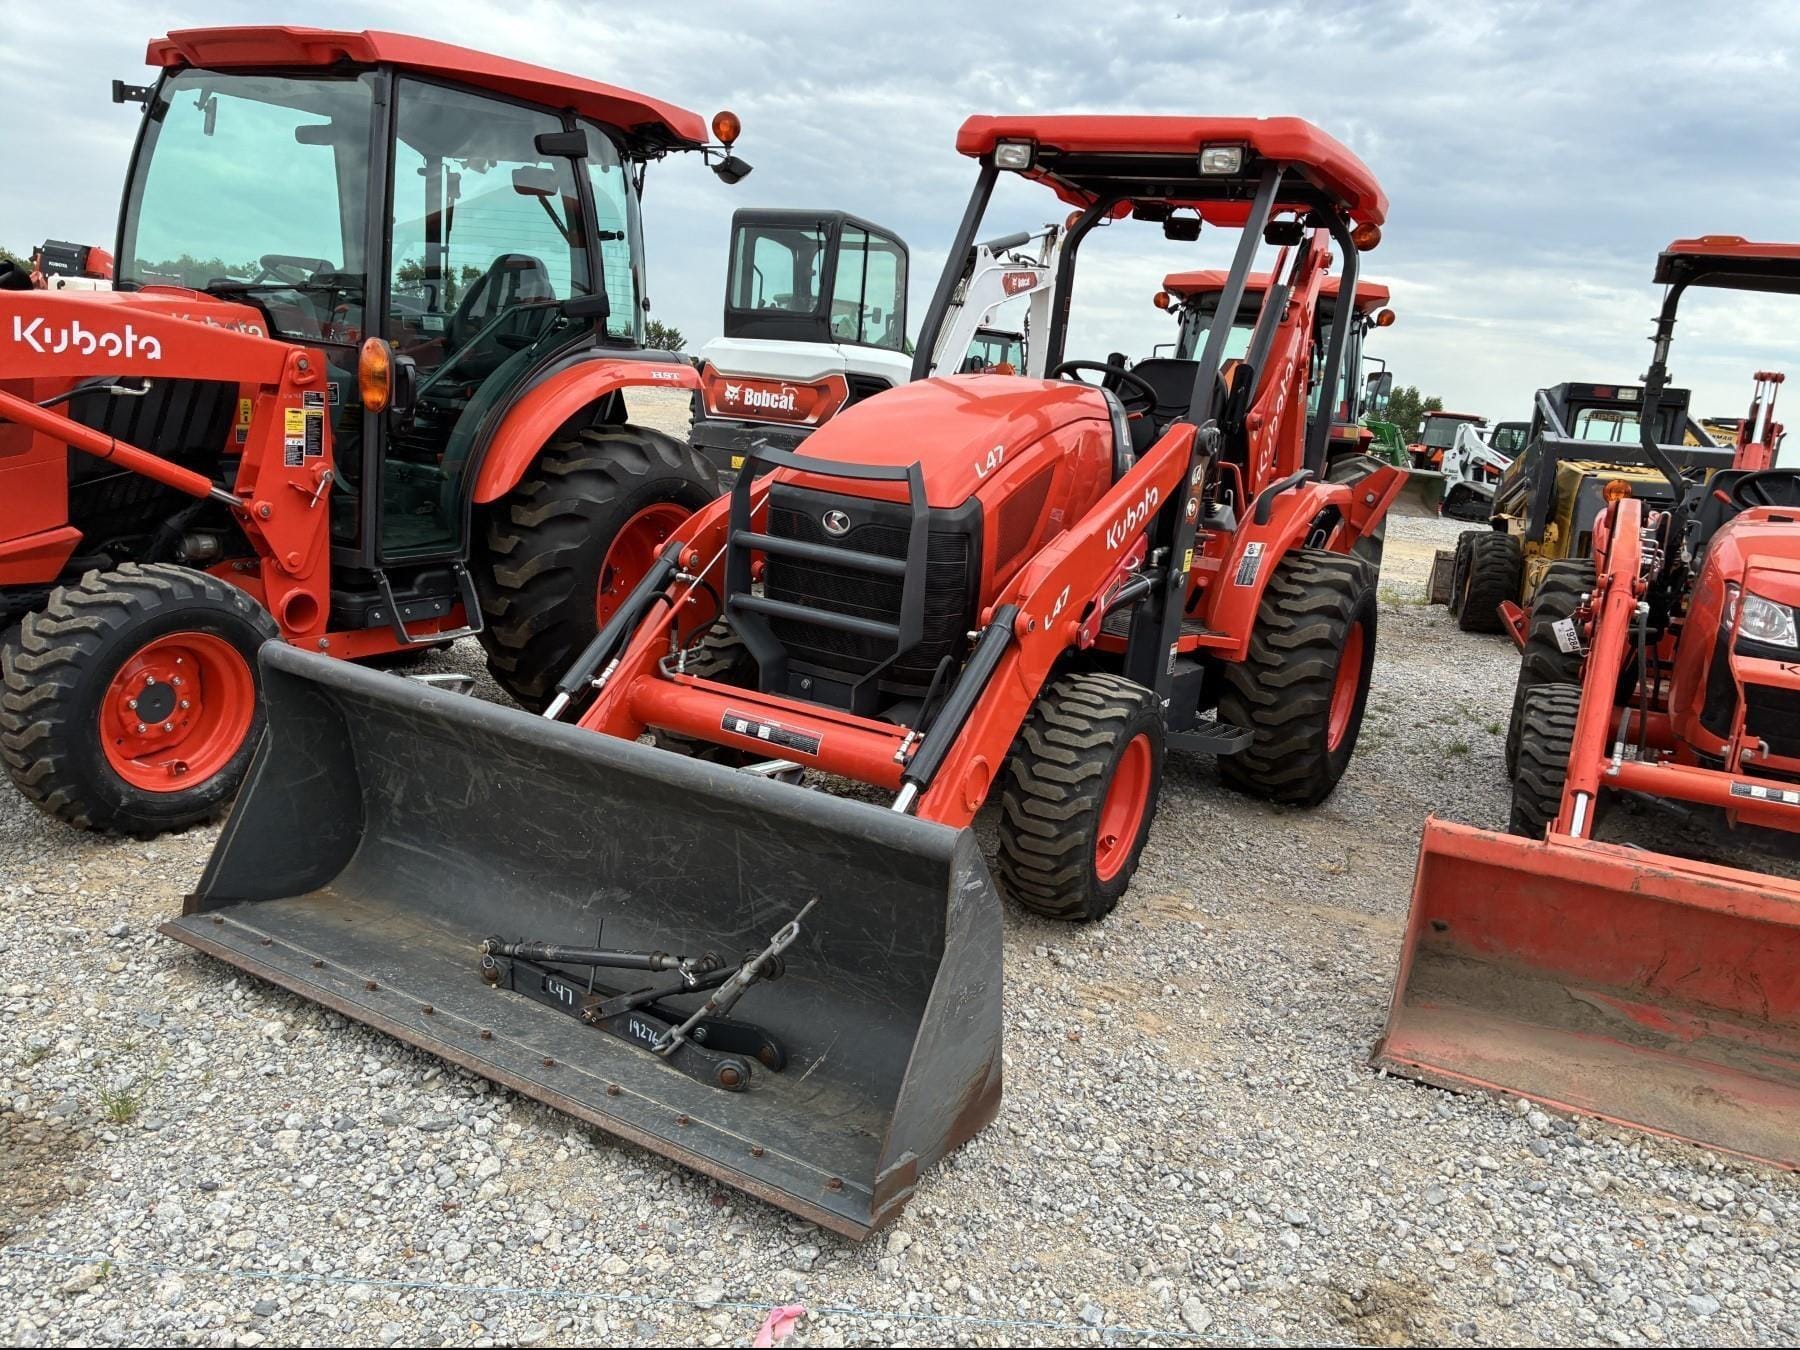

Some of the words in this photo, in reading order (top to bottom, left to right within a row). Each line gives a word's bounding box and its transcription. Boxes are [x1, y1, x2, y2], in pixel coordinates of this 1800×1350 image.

[13, 315, 161, 360] Kubota
[650, 371, 681, 380] HST
[744, 387, 795, 411] Bobcat
[1256, 360, 1294, 482] Kubota
[974, 444, 1004, 479] L47
[1106, 486, 1159, 551] Kubota
[1044, 584, 1071, 631] L47
[548, 979, 573, 1006] L47
[629, 1018, 659, 1046] 19276
